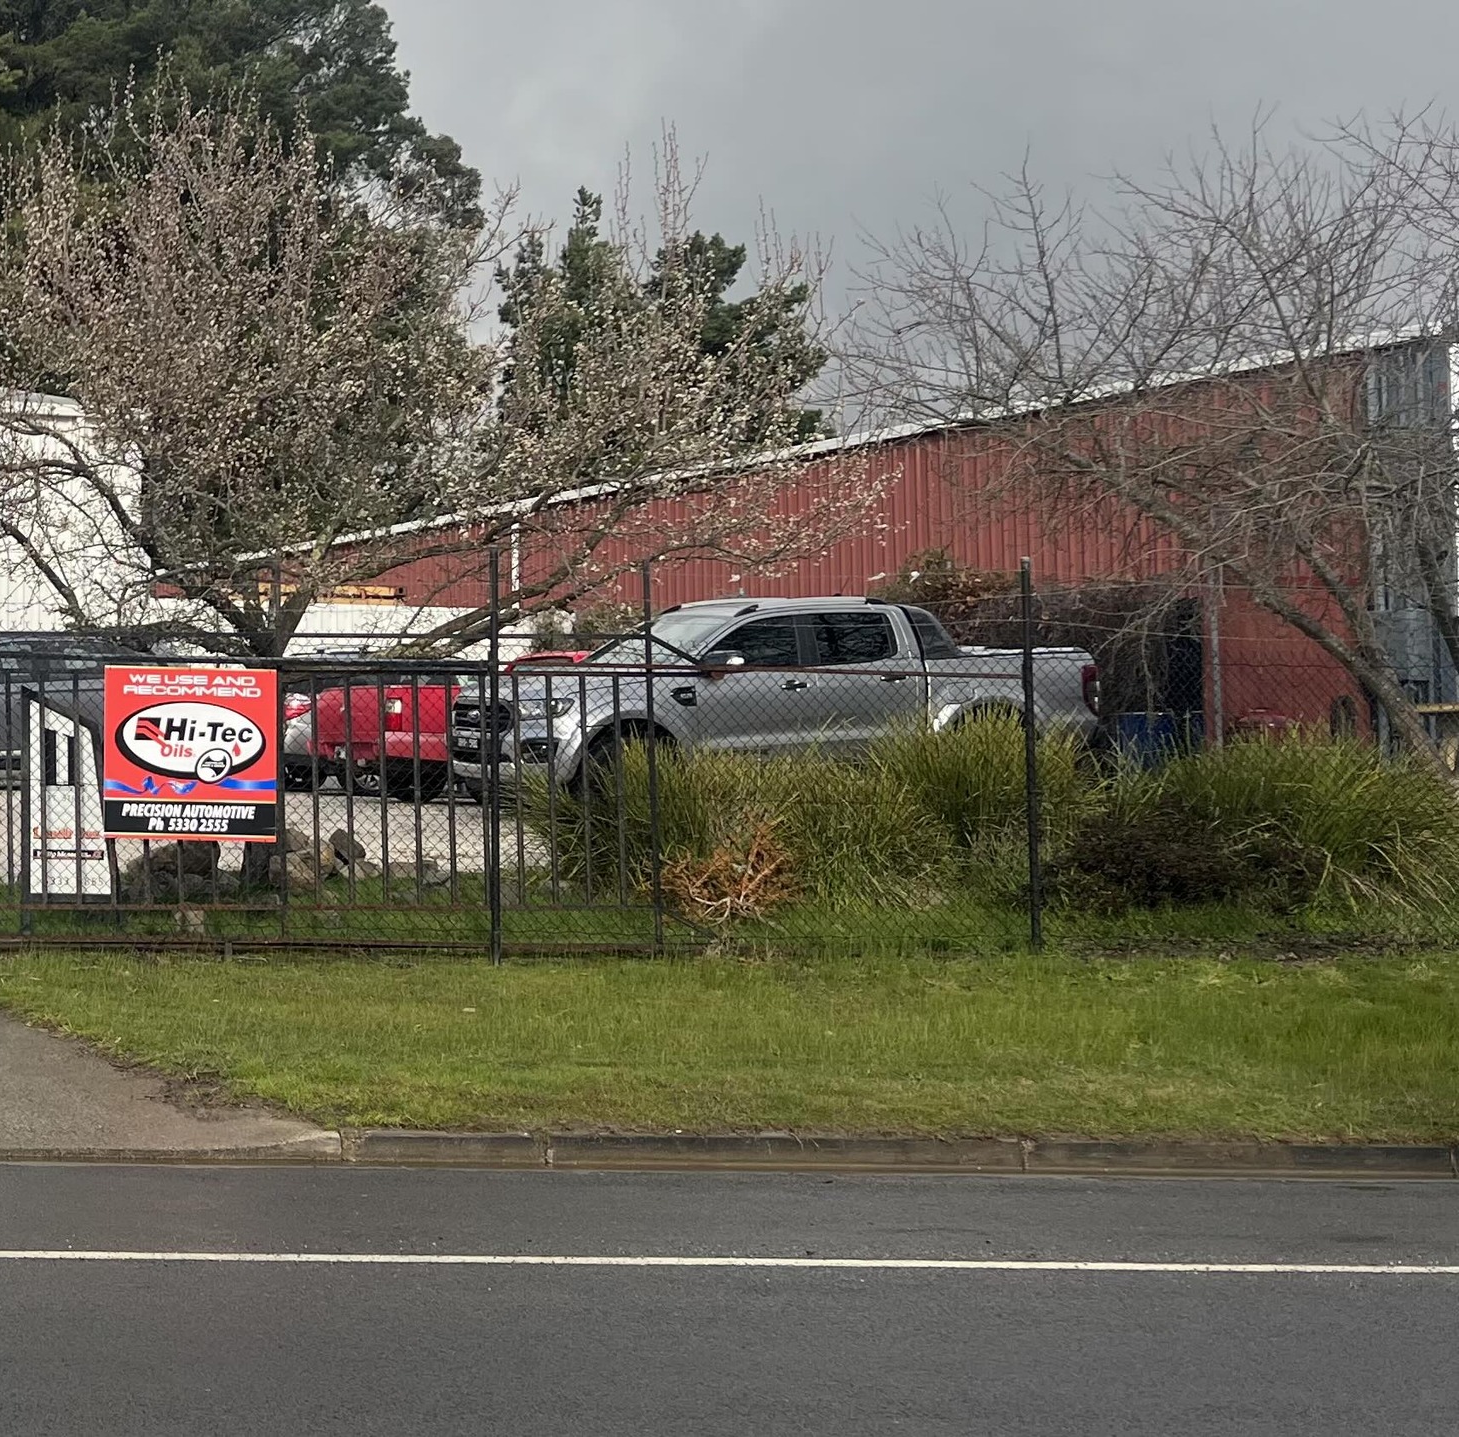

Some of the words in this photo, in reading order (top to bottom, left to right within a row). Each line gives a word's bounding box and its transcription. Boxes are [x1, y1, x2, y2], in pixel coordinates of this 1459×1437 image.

[129, 673, 161, 684] WE
[164, 674, 209, 685] USE
[212, 676, 256, 687] AND
[123, 685, 262, 698] RECOMMEND
[164, 717, 254, 743] Hi-Tec
[160, 744, 193, 758] Oils
[121, 803, 182, 818] PRECISION
[182, 805, 256, 820] AUTOMOTIVE
[147, 817, 164, 831] Ph
[168, 818, 198, 831] 5330
[199, 819, 229, 832] 2555
